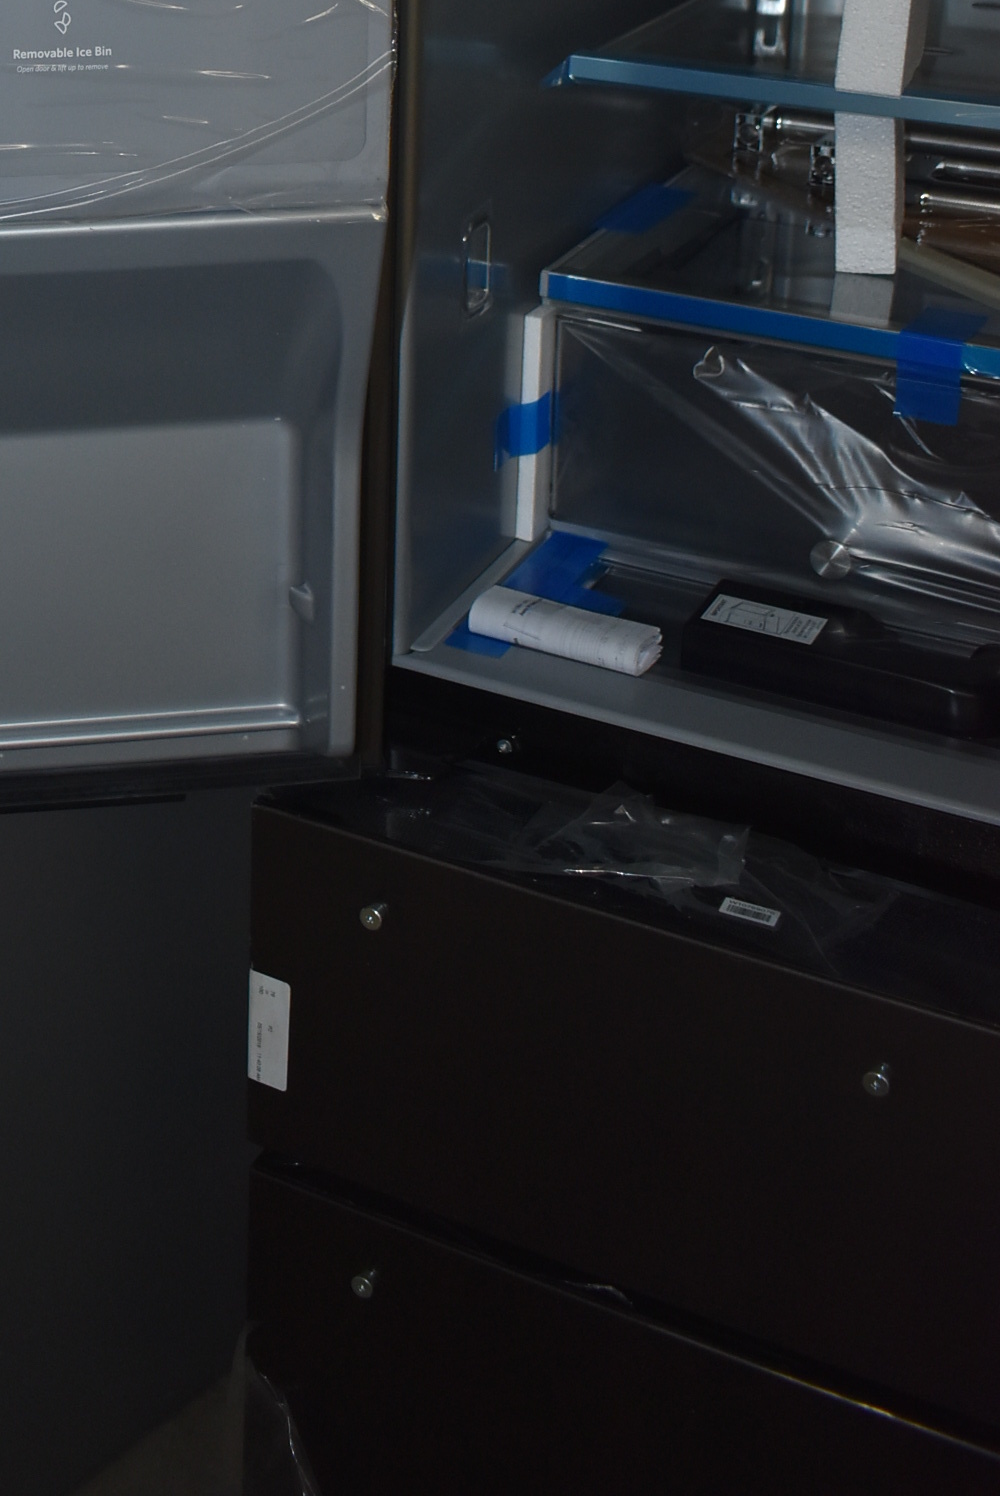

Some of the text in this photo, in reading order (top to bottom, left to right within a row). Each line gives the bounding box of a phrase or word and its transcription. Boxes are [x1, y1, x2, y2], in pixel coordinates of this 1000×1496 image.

[13, 45, 112, 60] Removable Ice Bin
[17, 65, 34, 74] Open
[35, 64, 49, 72] door
[50, 64, 57, 72] &
[57, 64, 67, 72] lift
[67, 64, 77, 72] up
